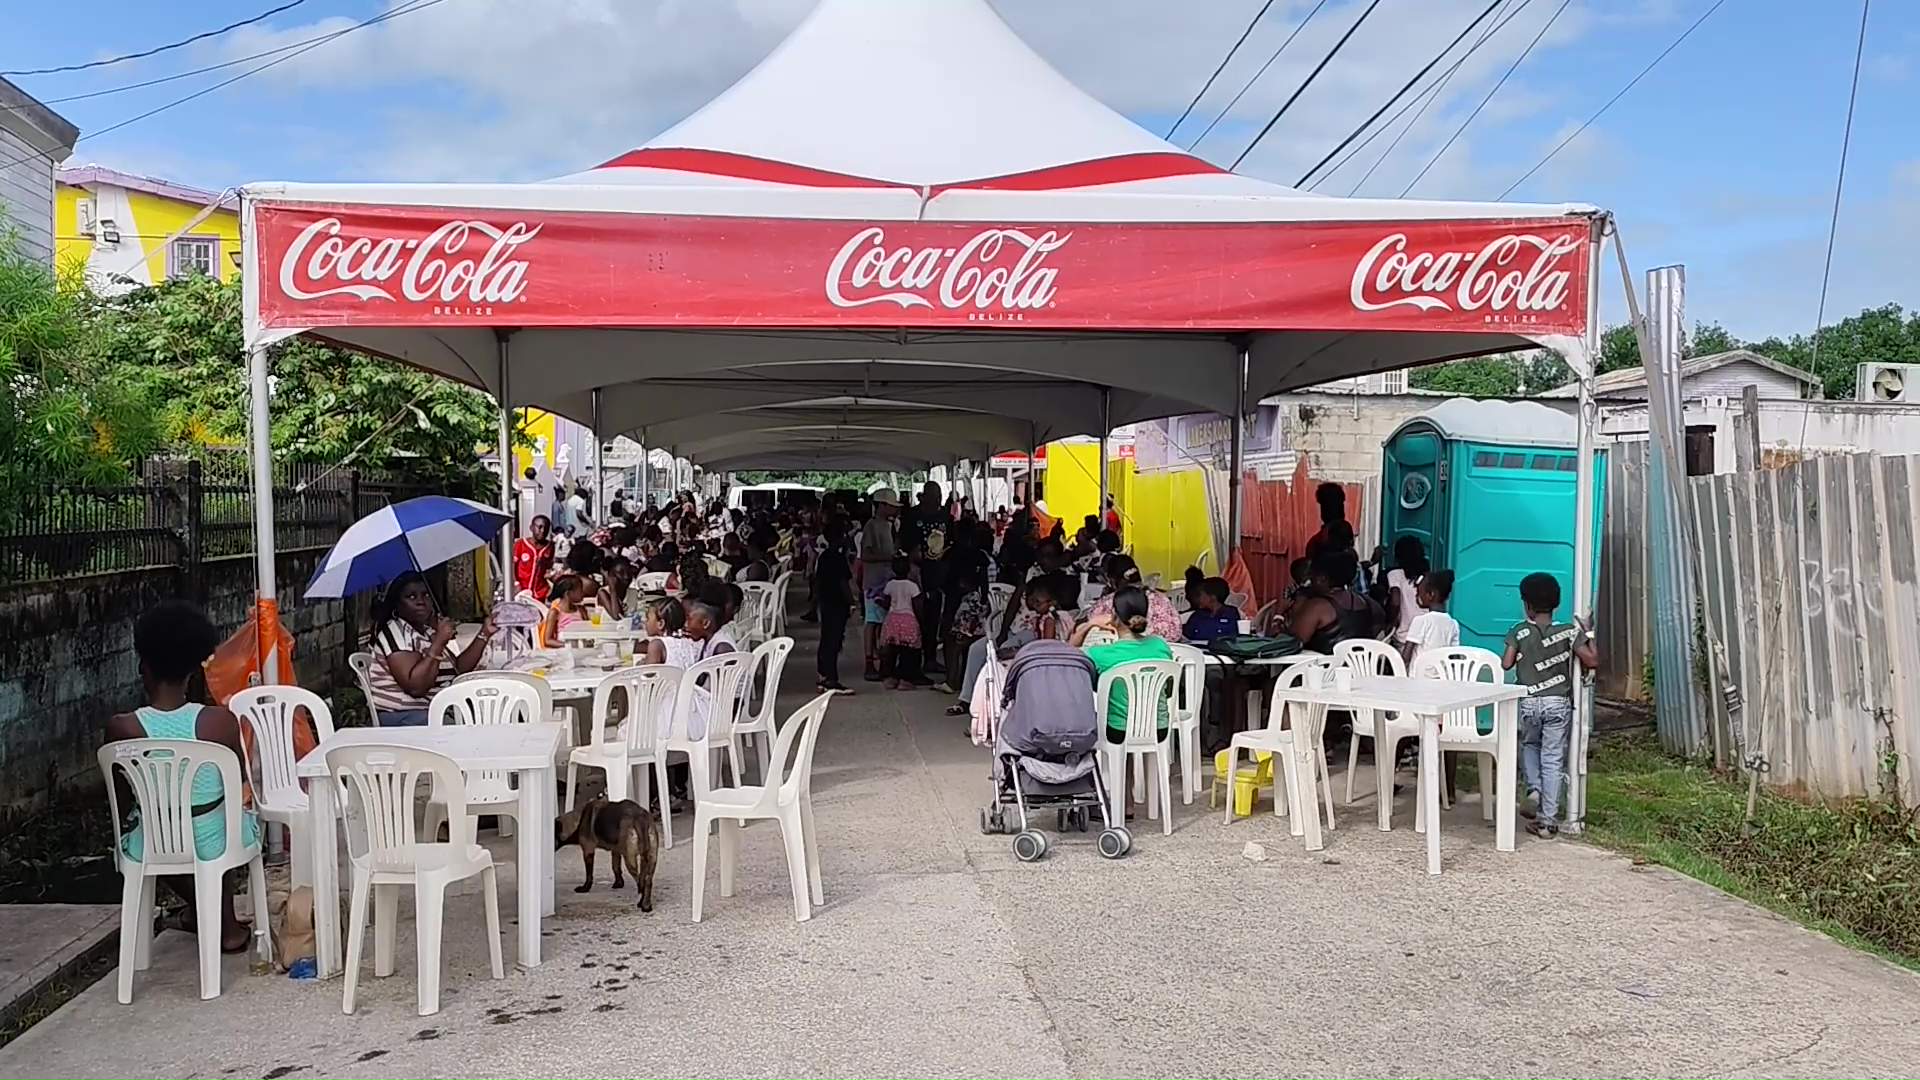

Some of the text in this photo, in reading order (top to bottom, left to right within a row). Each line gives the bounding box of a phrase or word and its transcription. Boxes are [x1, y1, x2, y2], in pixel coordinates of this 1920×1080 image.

[279, 217, 544, 303] Coca-Cola
[825, 226, 1074, 310] Coca-Cola
[1350, 233, 1586, 312] Coca-Cola
[433, 306, 494, 316] BELIZE
[968, 313, 1025, 321] BELIZE
[1484, 314, 1538, 323] BELIZE
[1528, 674, 1567, 694] BLESSED
